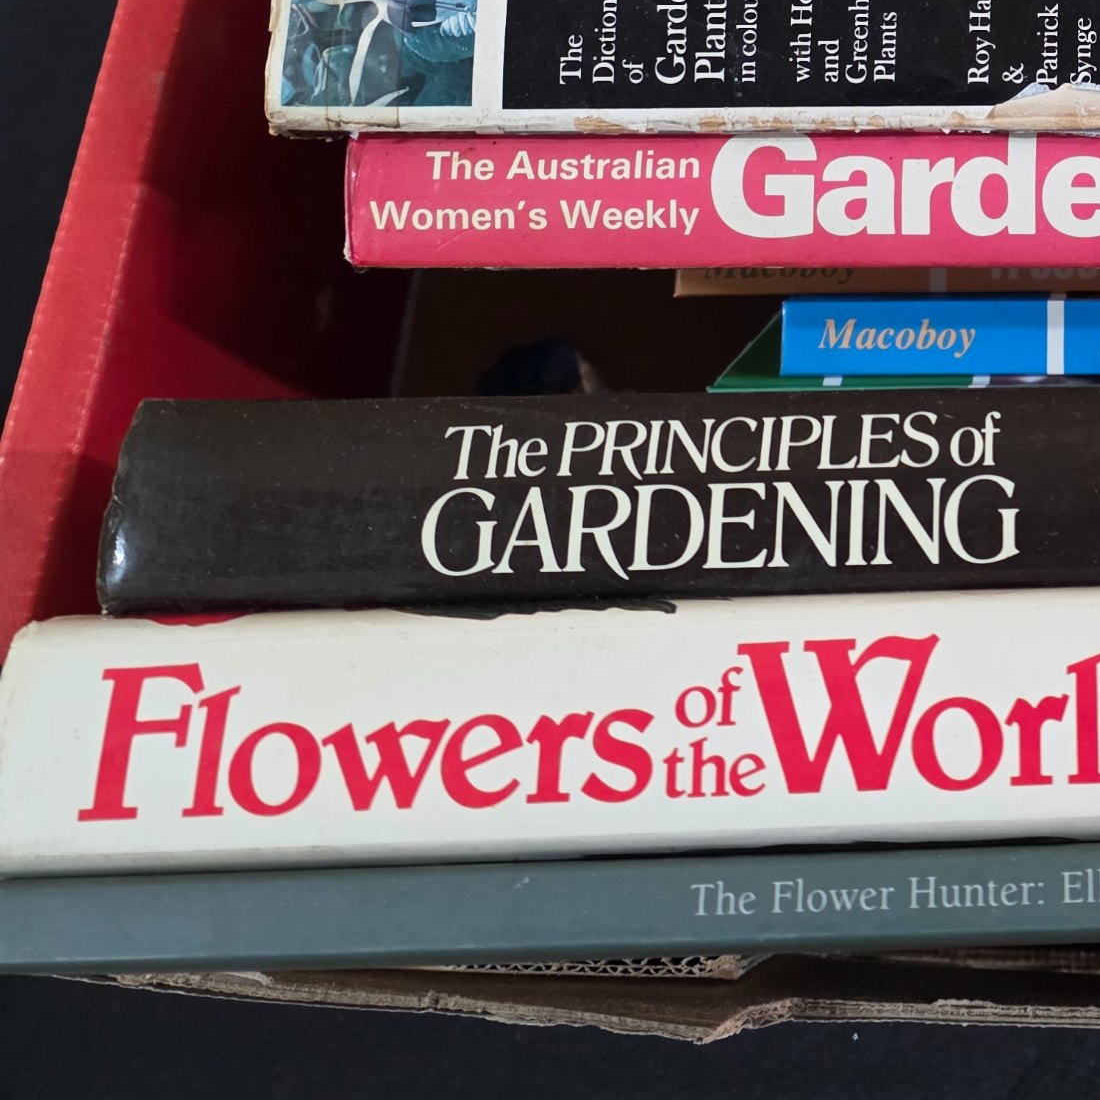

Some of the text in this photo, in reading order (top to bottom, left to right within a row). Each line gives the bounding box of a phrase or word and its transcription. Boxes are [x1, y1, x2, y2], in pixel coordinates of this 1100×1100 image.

[559, 34, 583, 84] The
[789, 33, 811, 82] with
[818, 38, 840, 84] and
[874, 10, 898, 82] Plants
[967, 36, 997, 84] Roy
[1036, 3, 1059, 85] Patrick
[1069, 17, 1098, 84] Synge
[622, 58, 644, 84] of
[735, 63, 756, 83] in
[1001, 62, 1024, 84] &
[425, 149, 701, 181] The Australian
[369, 199, 700, 236] Women's Weekly
[819, 318, 976, 358] Macoboy
[444, 411, 1002, 480] The PRINCIPLES of
[421, 474, 1022, 581] GARDENING
[676, 666, 742, 728] of
[78, 662, 654, 821] Flowers
[662, 743, 765, 798] the
[690, 879, 763, 918] The
[770, 875, 895, 915] Flower
[907, 871, 1046, 913] Hunter:
